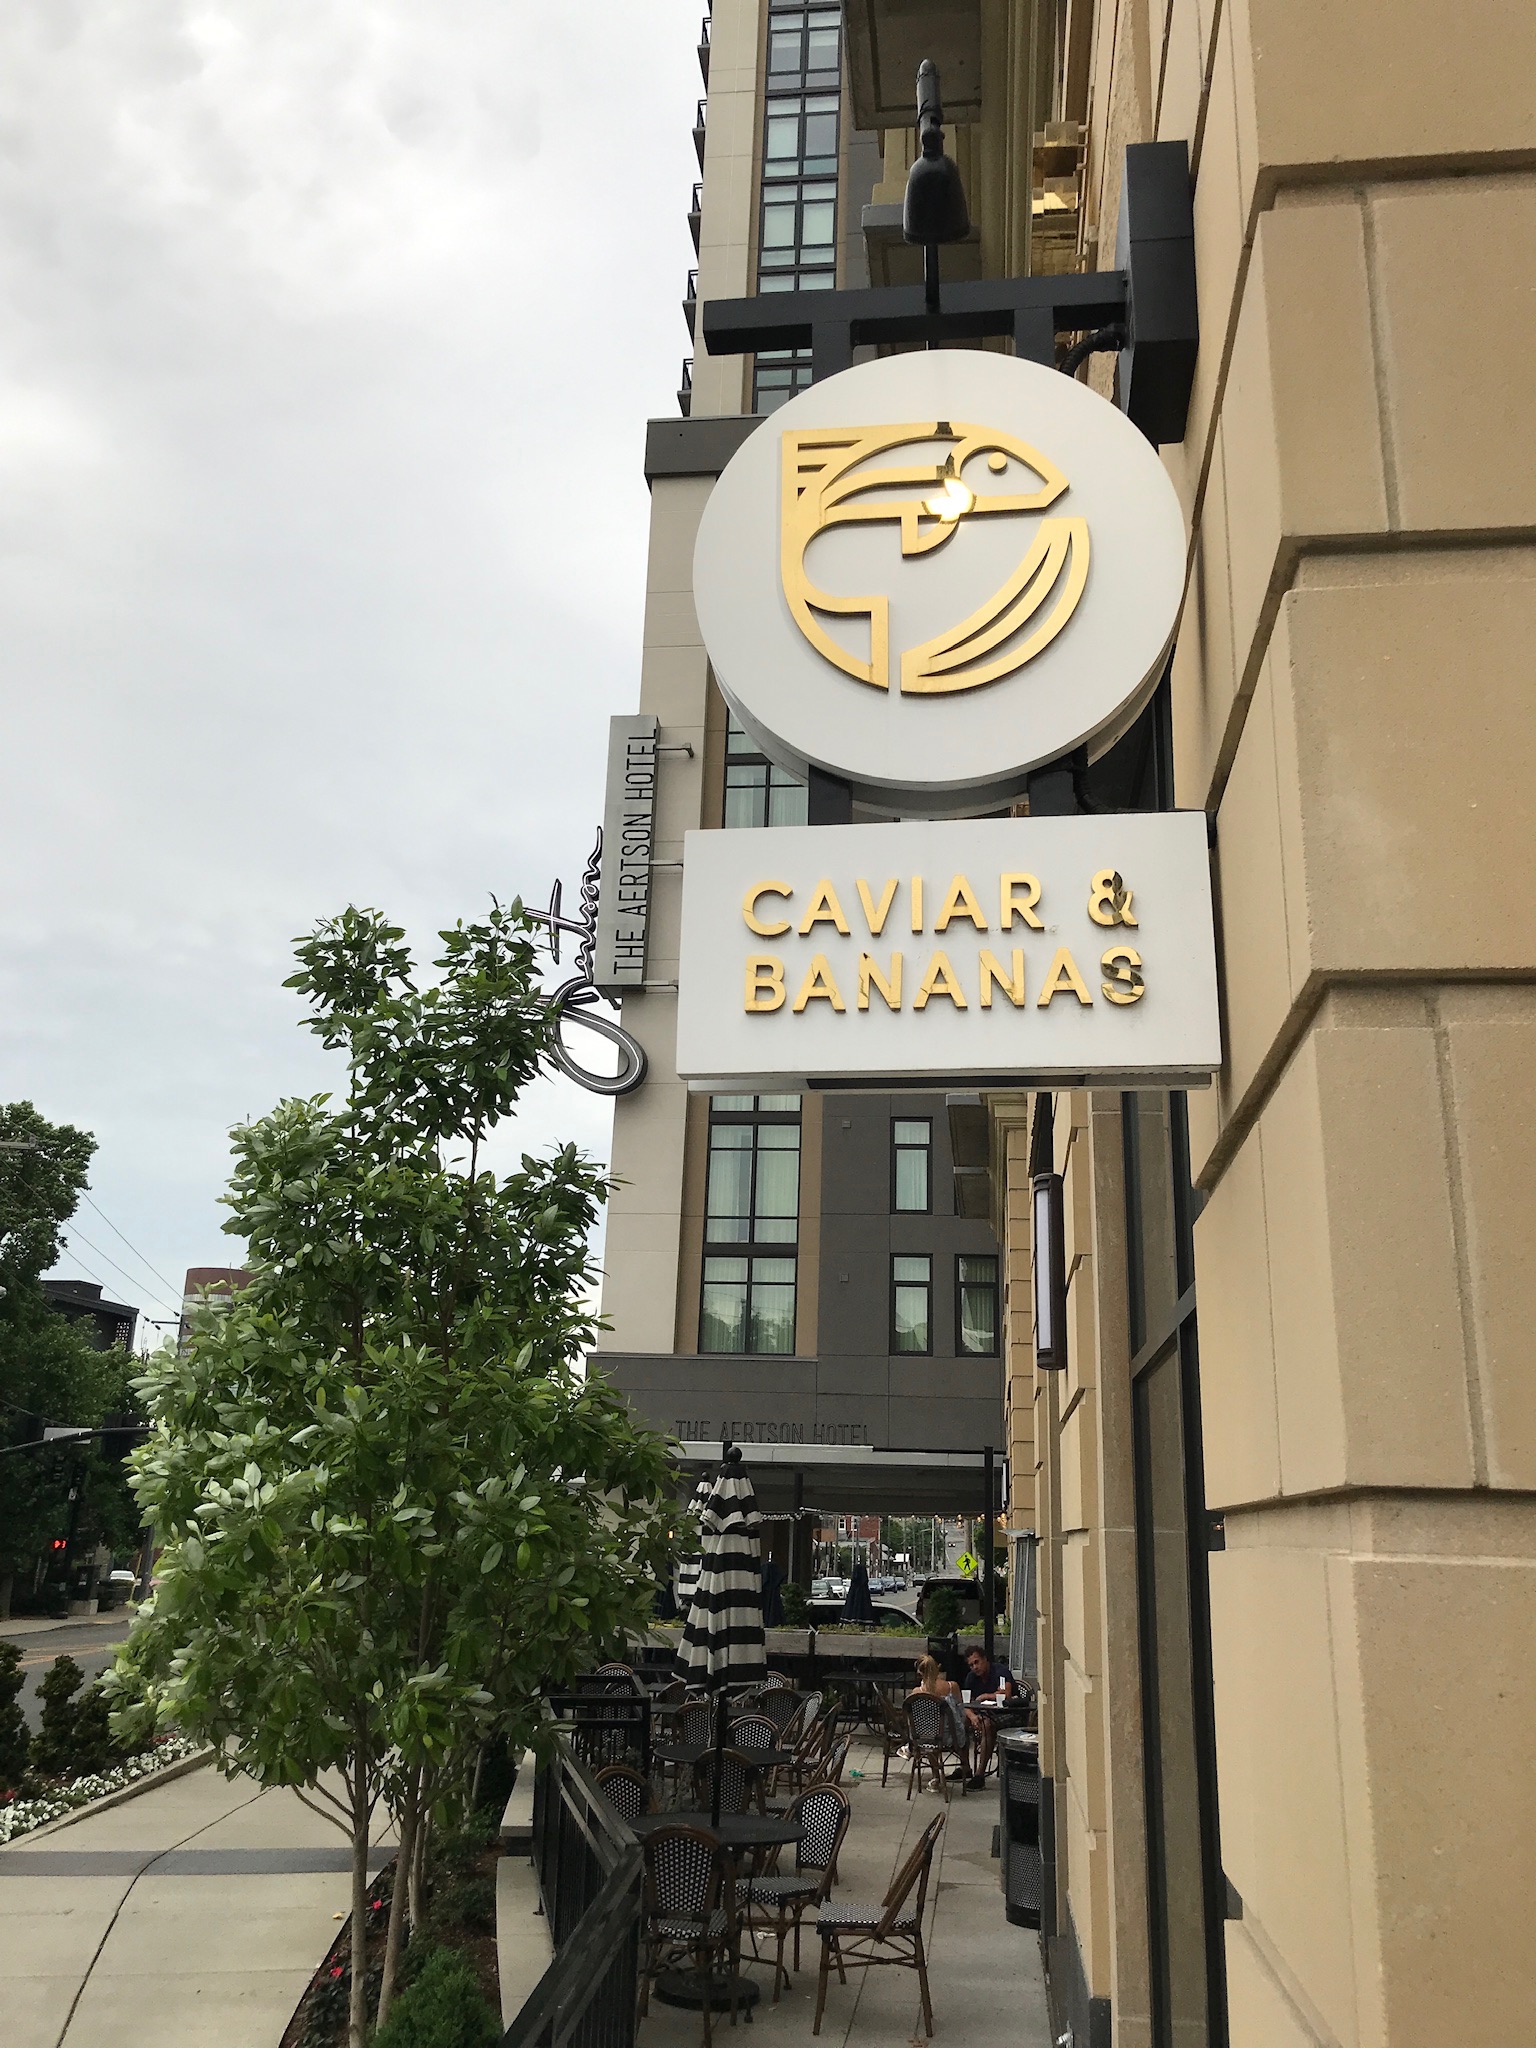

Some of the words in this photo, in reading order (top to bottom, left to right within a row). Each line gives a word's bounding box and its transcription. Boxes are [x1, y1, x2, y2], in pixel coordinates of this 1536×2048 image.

[624, 728, 657, 800] HOTEL
[617, 813, 652, 917] AERTSON
[743, 872, 1045, 936] CAVIAR
[1088, 869, 1139, 929] &
[613, 929, 646, 975] THE
[744, 946, 1146, 1013] BANANAS
[675, 1420, 711, 1441] THE
[719, 1421, 804, 1443] AERTSON
